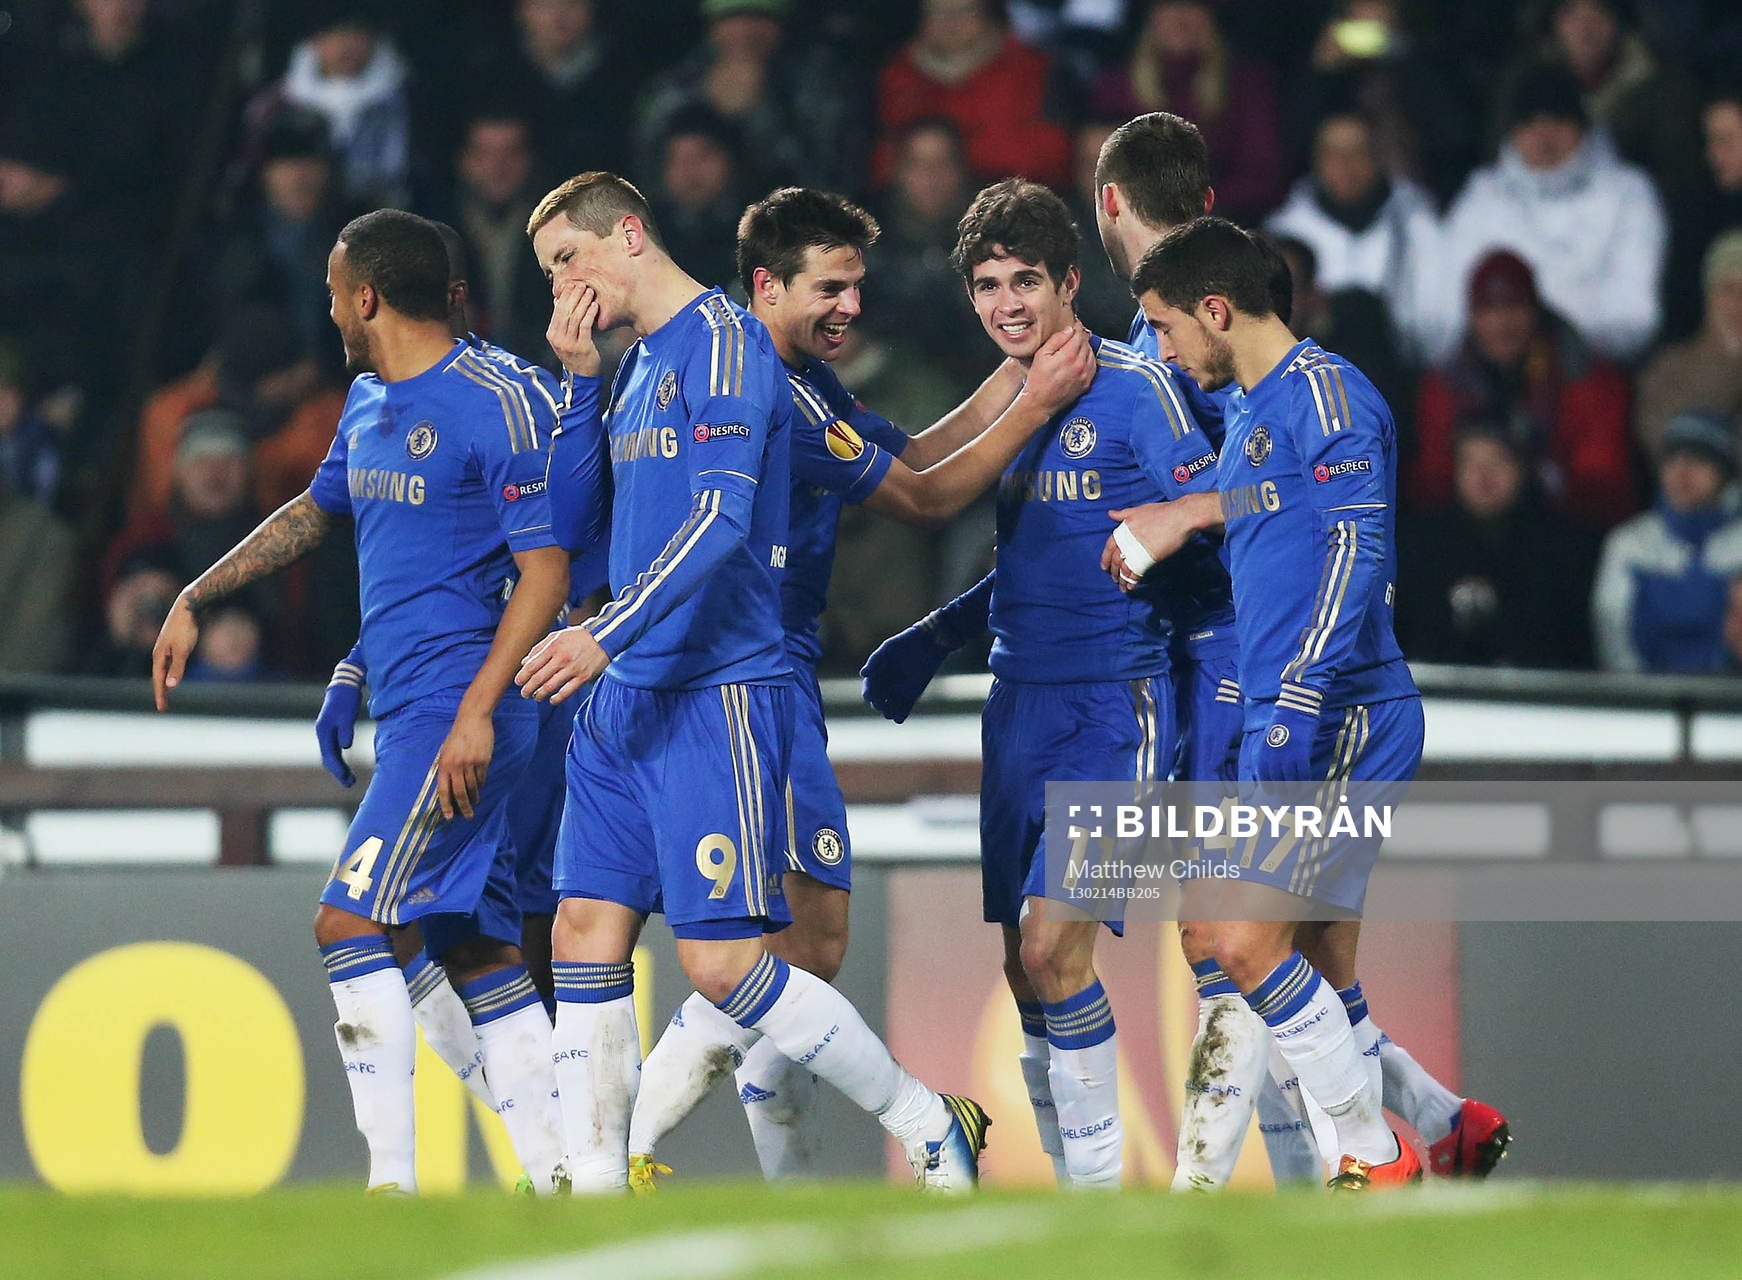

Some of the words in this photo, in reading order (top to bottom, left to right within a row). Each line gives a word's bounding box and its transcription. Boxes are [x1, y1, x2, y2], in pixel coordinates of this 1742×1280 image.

[710, 425, 750, 438] RESPECT
[1329, 460, 1371, 476] RESPECT
[338, 835, 384, 901] 4
[695, 833, 737, 900] 9
[570, 1049, 589, 1060] FC
[359, 1062, 376, 1074] FC
[1226, 1084, 1241, 1097] FC
